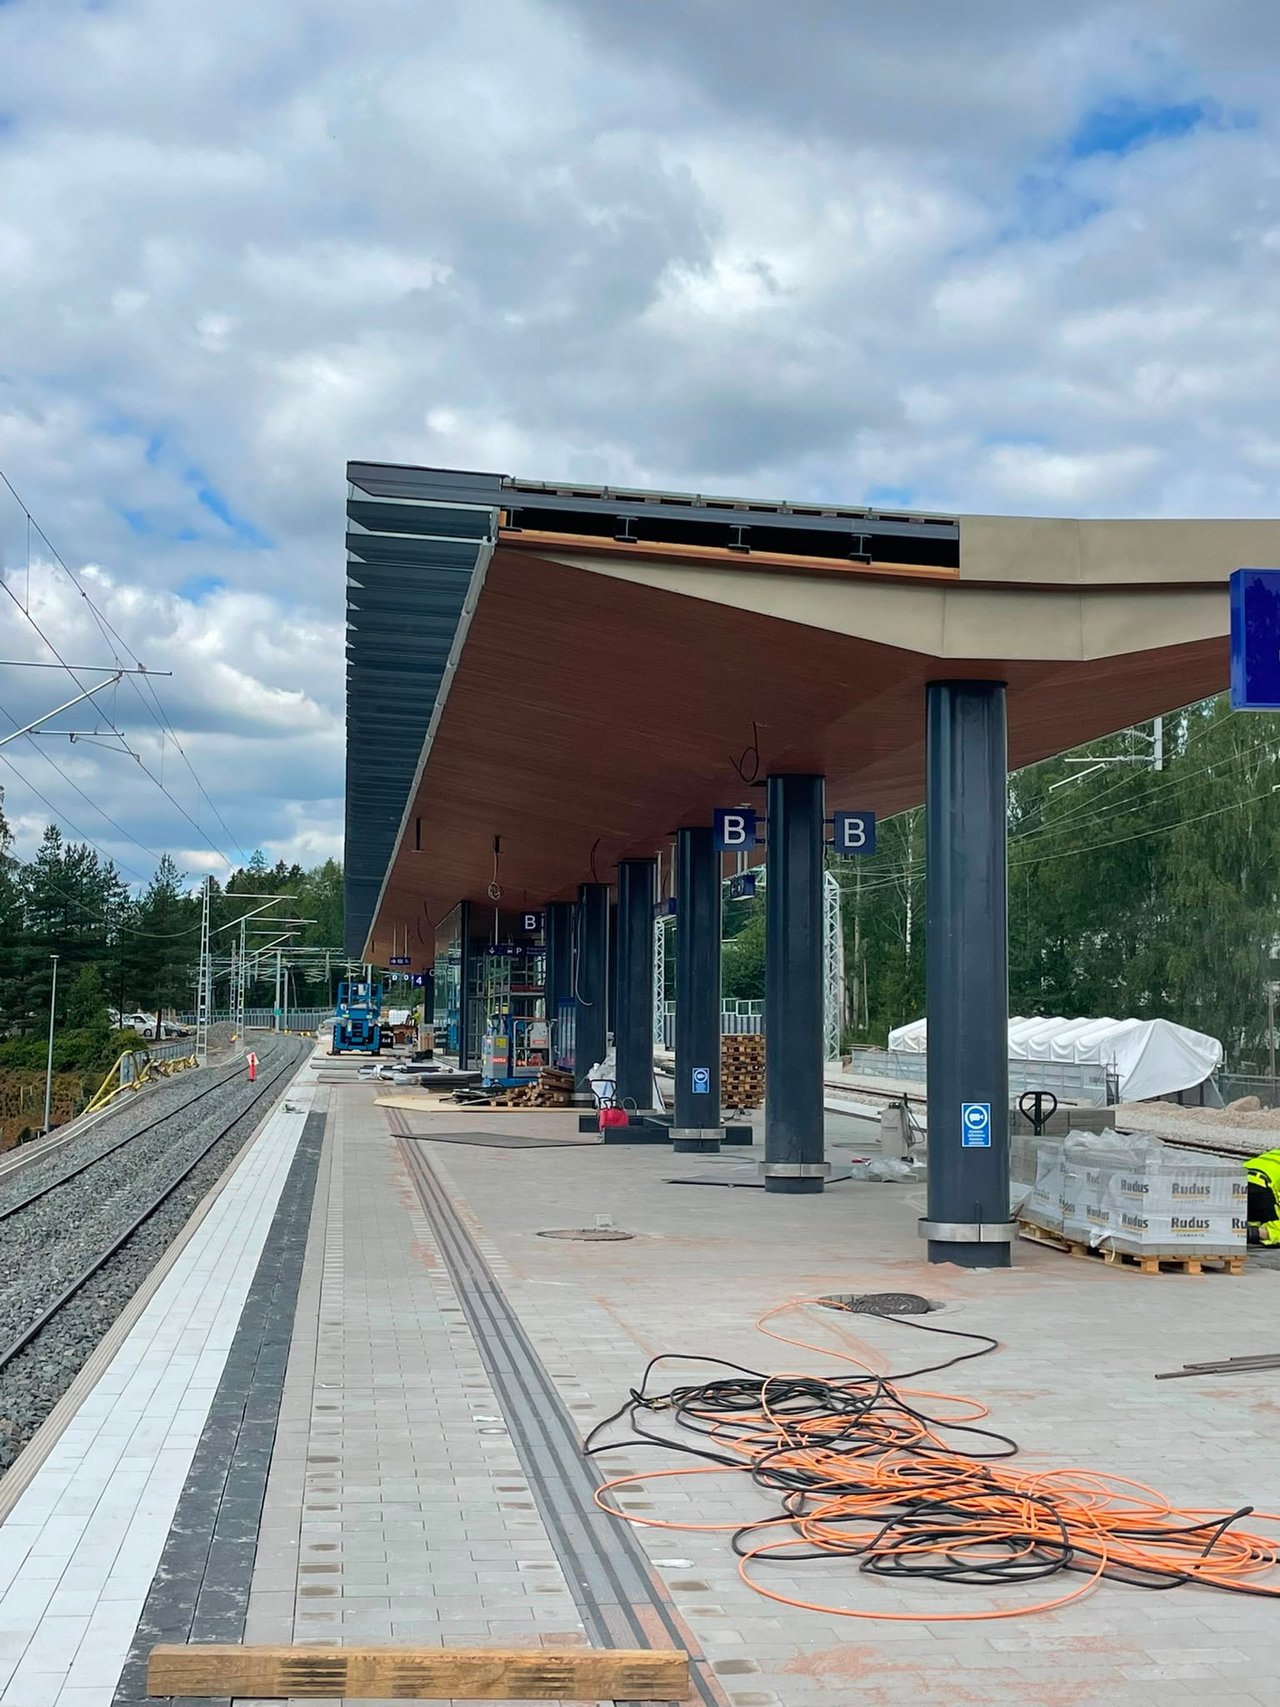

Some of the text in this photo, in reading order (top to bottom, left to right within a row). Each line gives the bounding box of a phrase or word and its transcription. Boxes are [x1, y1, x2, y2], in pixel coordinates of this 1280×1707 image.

[724, 815, 746, 844] B
[844, 818, 866, 847] B
[524, 915, 536, 930] B
[1121, 1179, 1149, 1193] Rudus
[1172, 1183, 1211, 1195] Rudus
[1122, 1213, 1149, 1229] Rudus
[1171, 1216, 1210, 1229] Rudus
